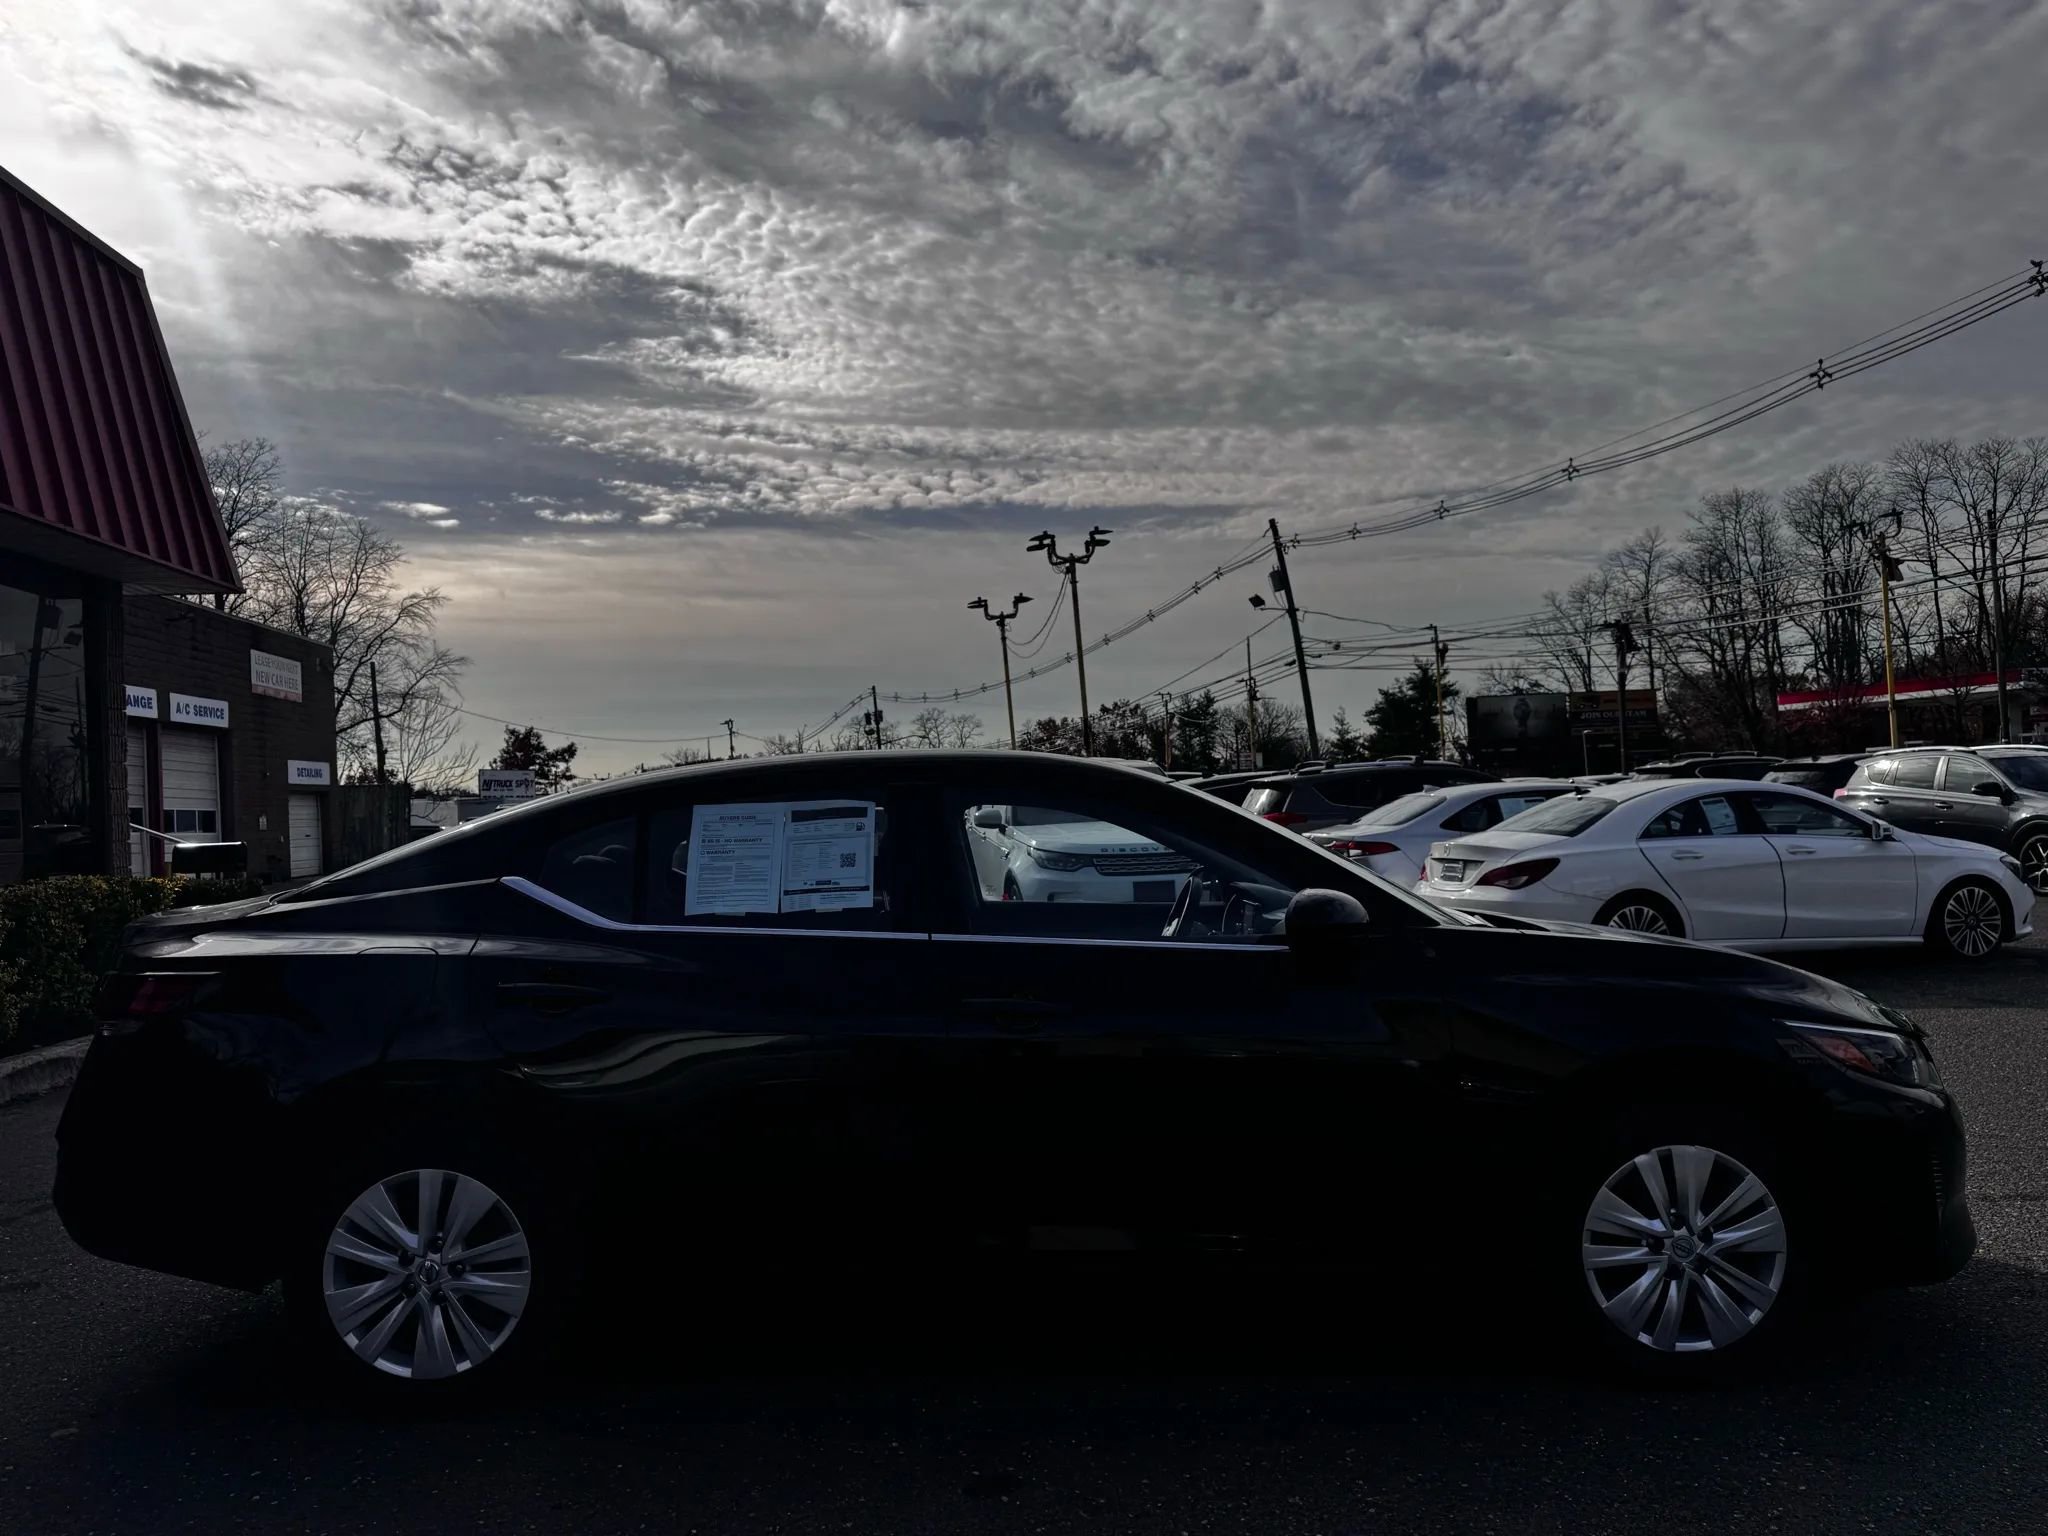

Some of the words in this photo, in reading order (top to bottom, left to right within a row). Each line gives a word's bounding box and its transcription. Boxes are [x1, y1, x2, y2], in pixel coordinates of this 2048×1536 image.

[255, 670, 270, 684] NEW
[271, 673, 284, 687] CAR
[176, 702, 191, 715] A/C
[193, 704, 224, 720] SERVICE
[296, 767, 323, 778] DETAILING
[493, 780, 513, 788] TRUCK
